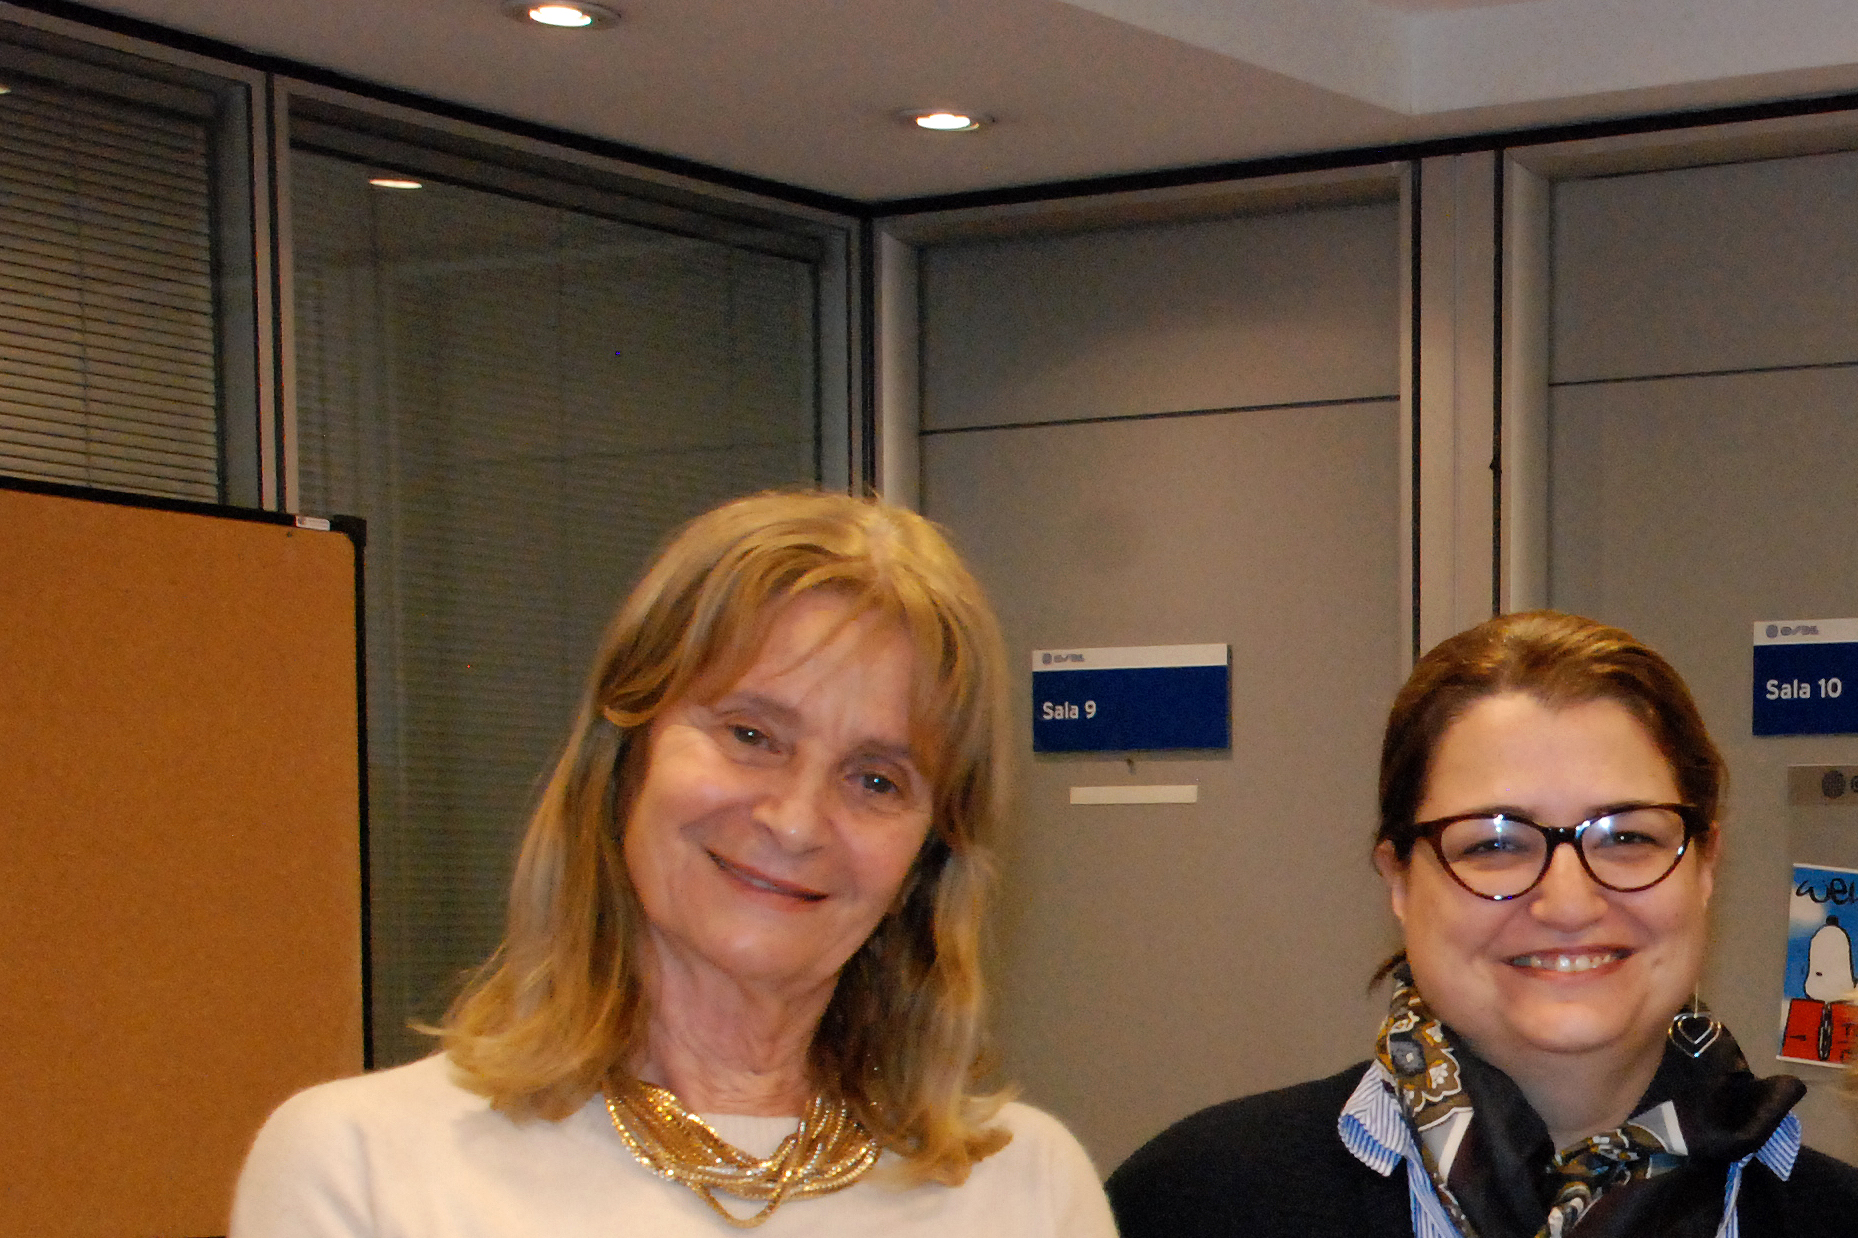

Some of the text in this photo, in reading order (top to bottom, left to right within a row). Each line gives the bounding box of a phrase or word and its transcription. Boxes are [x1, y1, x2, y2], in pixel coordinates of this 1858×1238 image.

[1765, 677, 1842, 700] Sala 10
[1042, 700, 1097, 720] Sala 9
